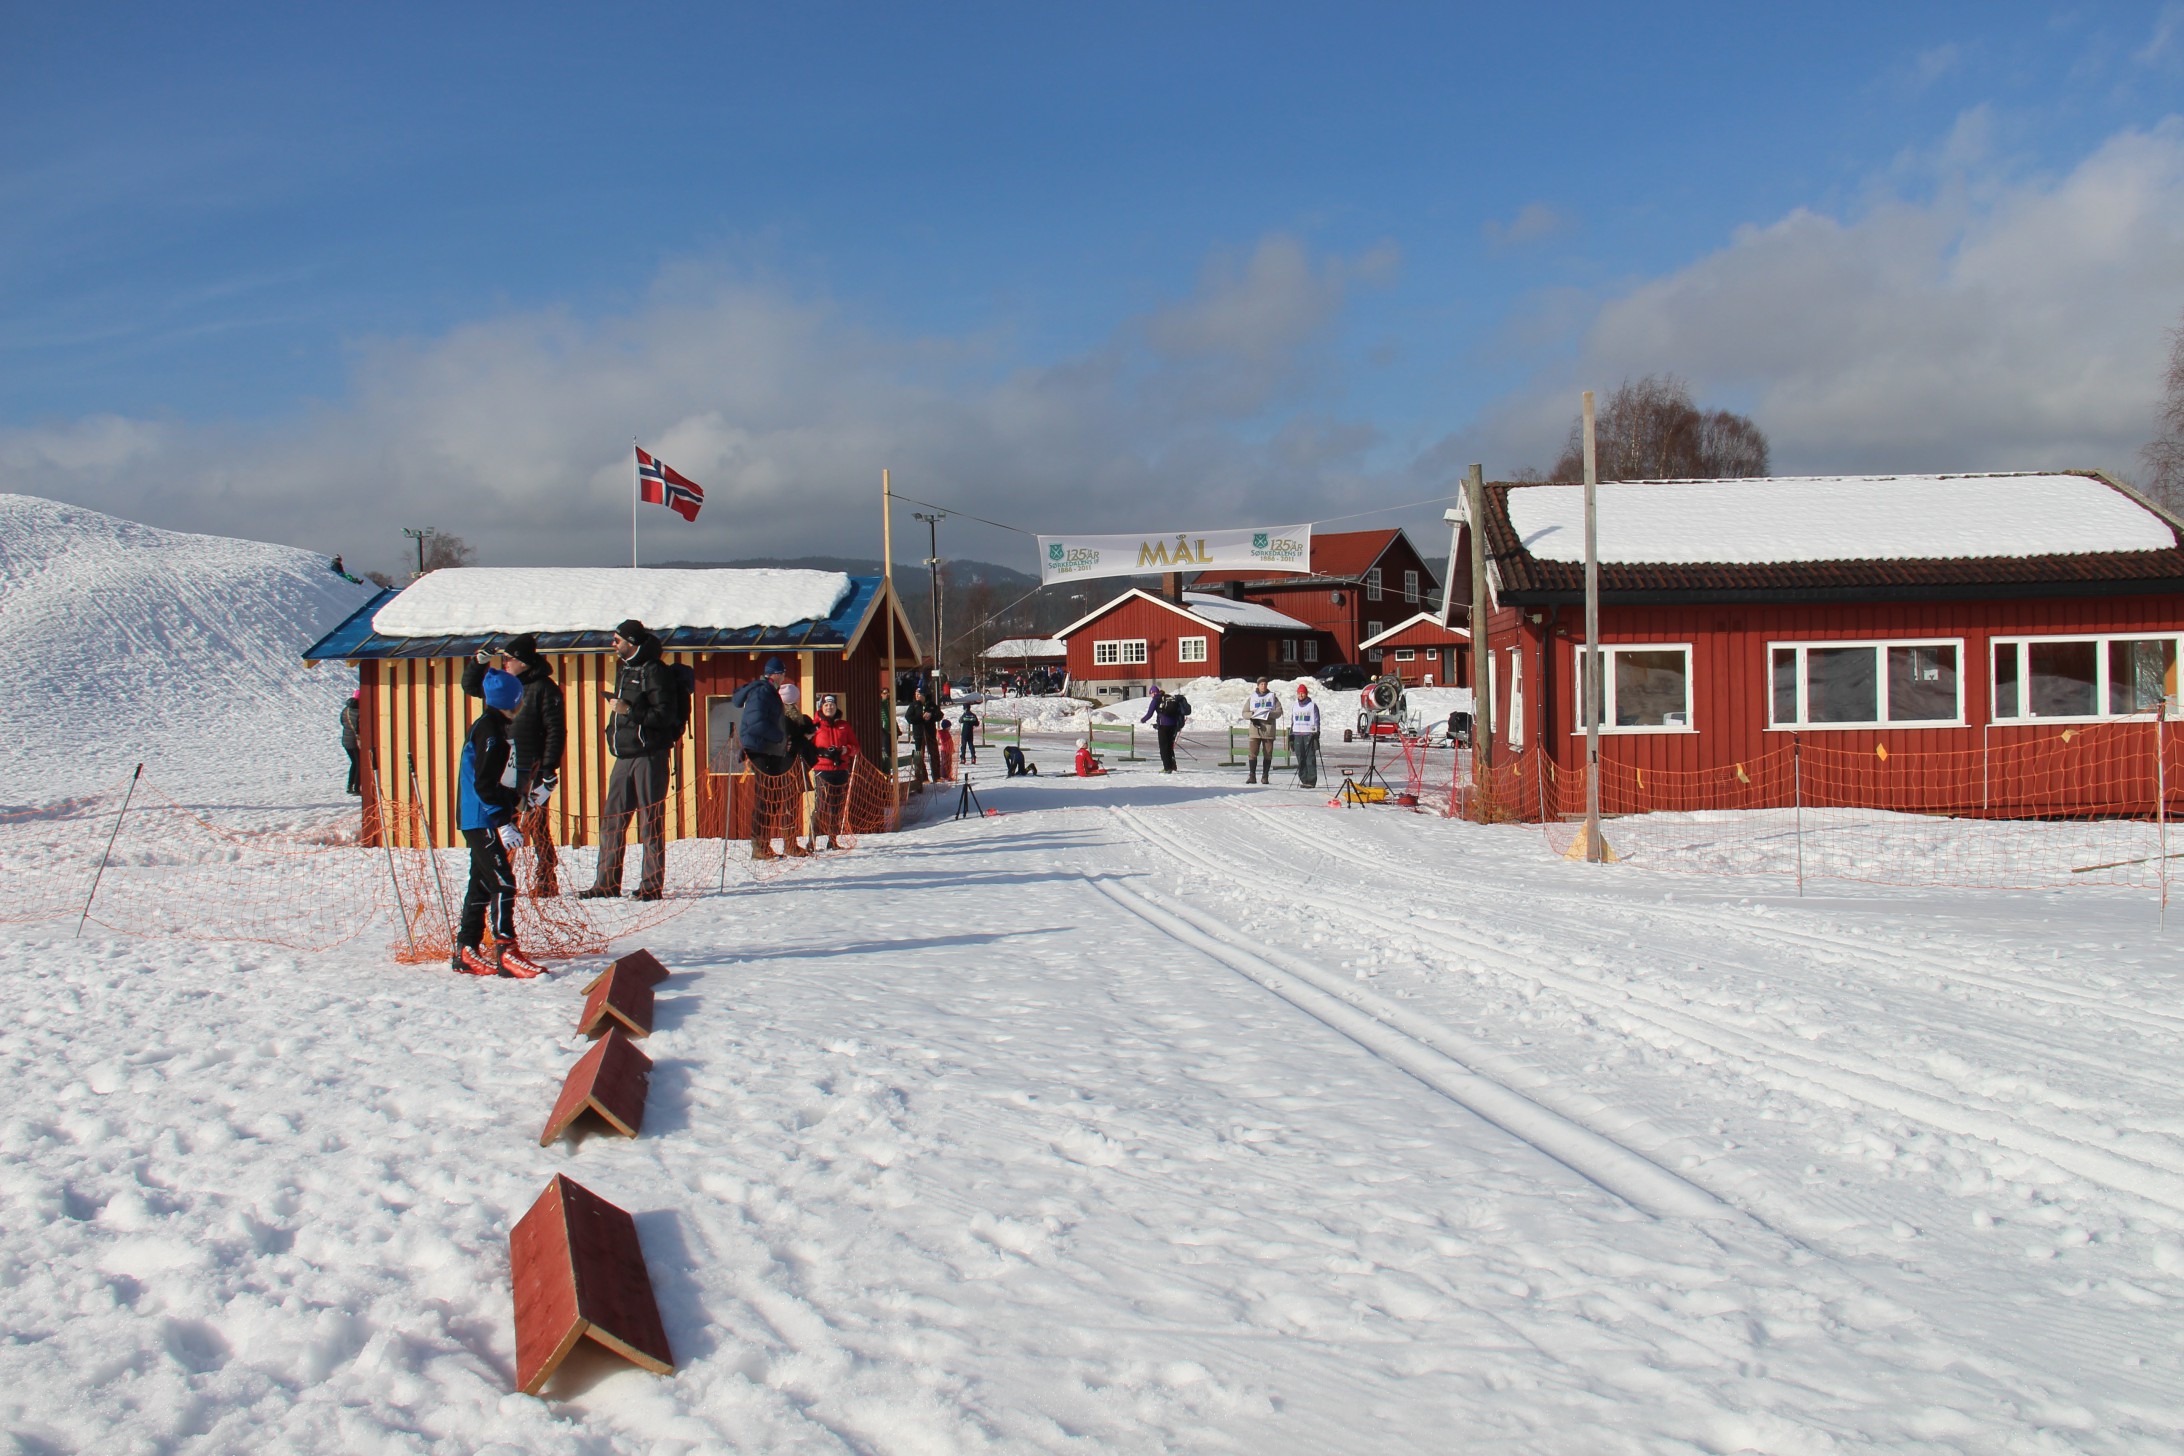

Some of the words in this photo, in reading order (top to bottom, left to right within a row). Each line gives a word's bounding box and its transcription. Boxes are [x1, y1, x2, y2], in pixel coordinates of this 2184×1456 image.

[1136, 534, 1213, 567] MÅL
[1271, 539, 1291, 551] 125
[1066, 548, 1087, 561] 125
